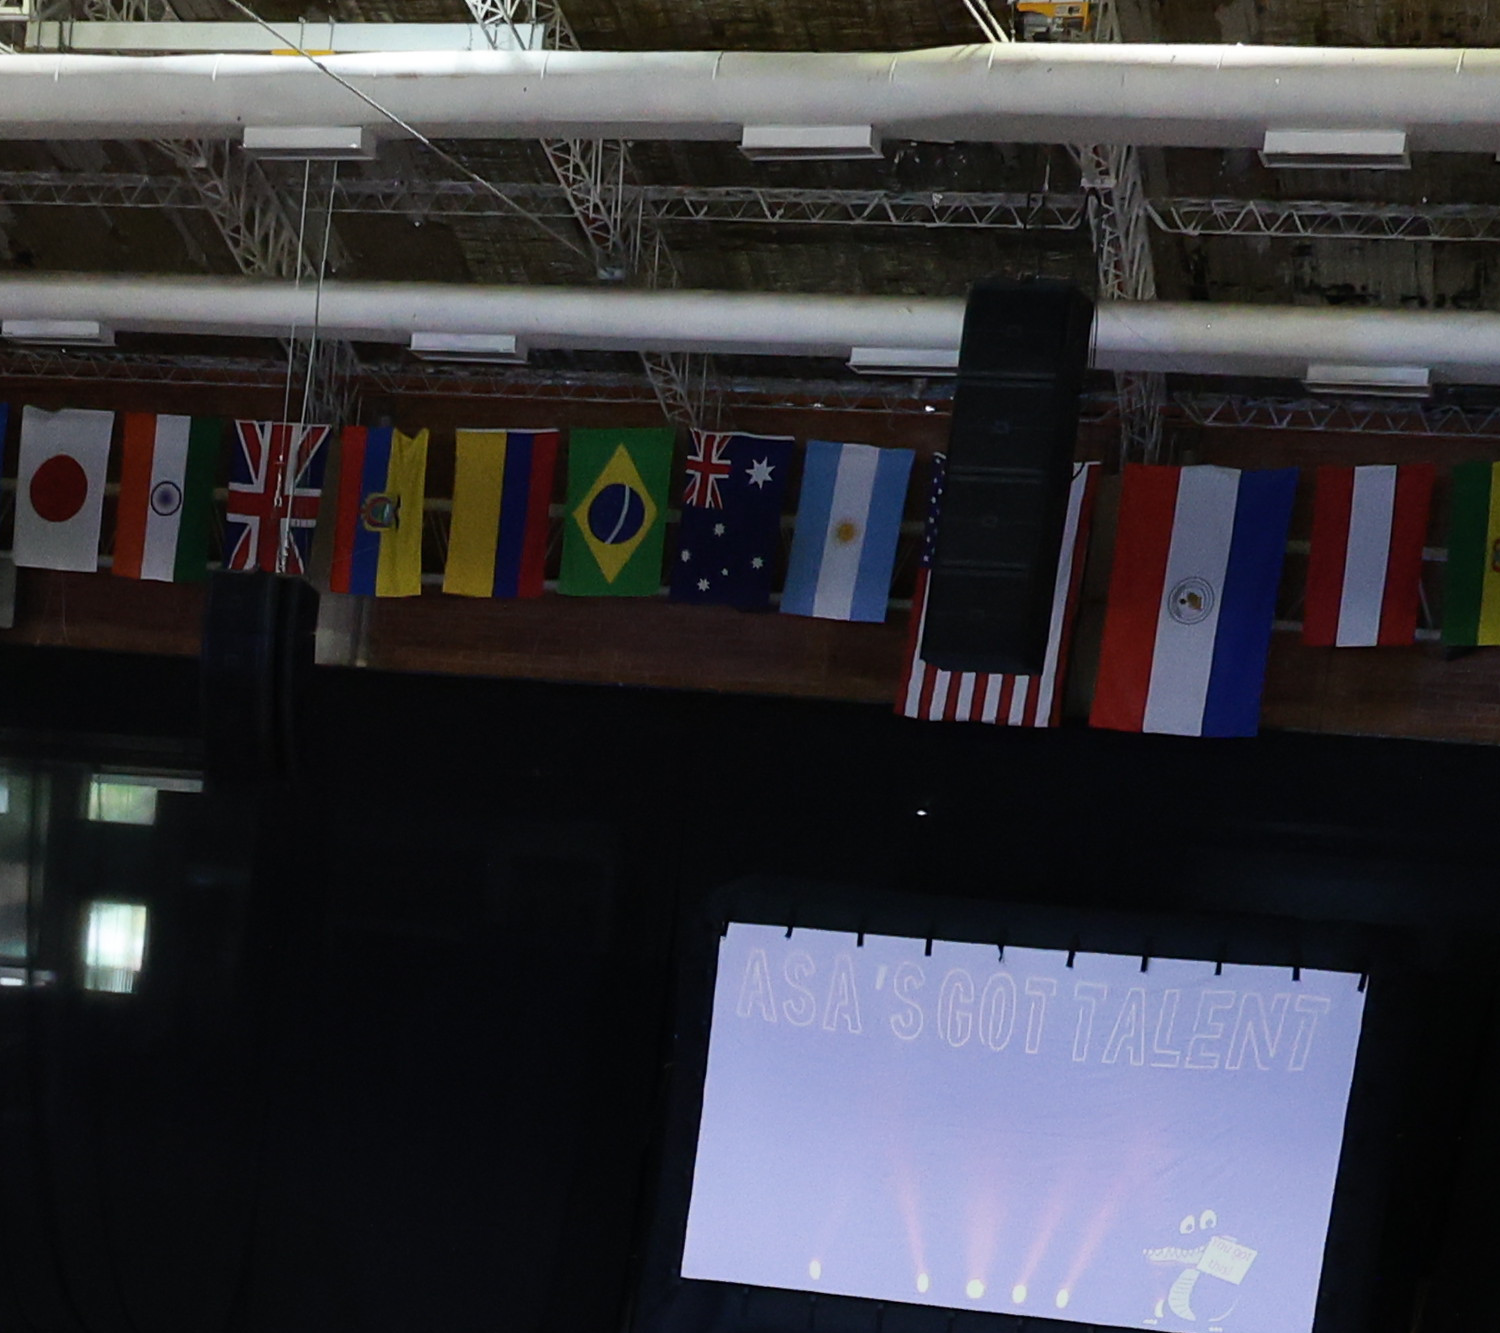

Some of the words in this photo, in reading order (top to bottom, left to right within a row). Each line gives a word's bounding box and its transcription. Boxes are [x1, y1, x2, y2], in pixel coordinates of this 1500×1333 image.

[736, 947, 926, 1041] ASA'S
[936, 968, 1058, 1053] GOT
[1070, 981, 1331, 1071] TALENT
